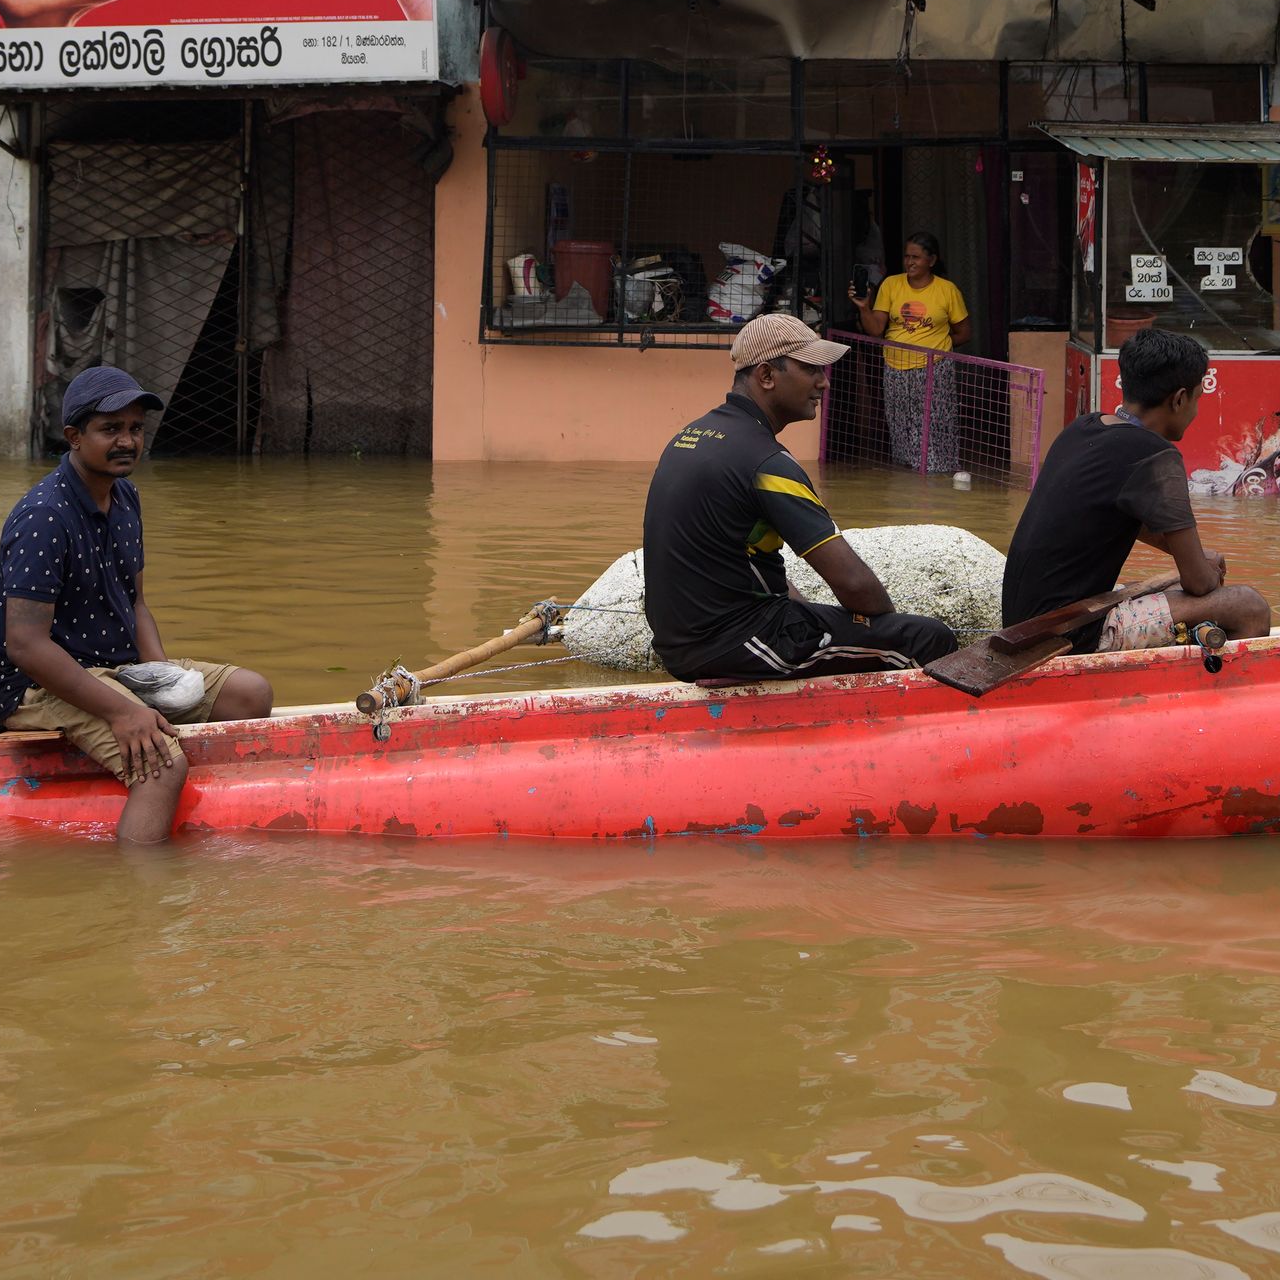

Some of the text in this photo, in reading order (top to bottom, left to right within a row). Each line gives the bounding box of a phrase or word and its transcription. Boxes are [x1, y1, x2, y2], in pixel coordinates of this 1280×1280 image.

[322, 36, 337, 47] 182
[59, 28, 166, 78] ලක්මාලි
[1221, 278, 1233, 287] 20
[1151, 287, 1170, 298] 100
